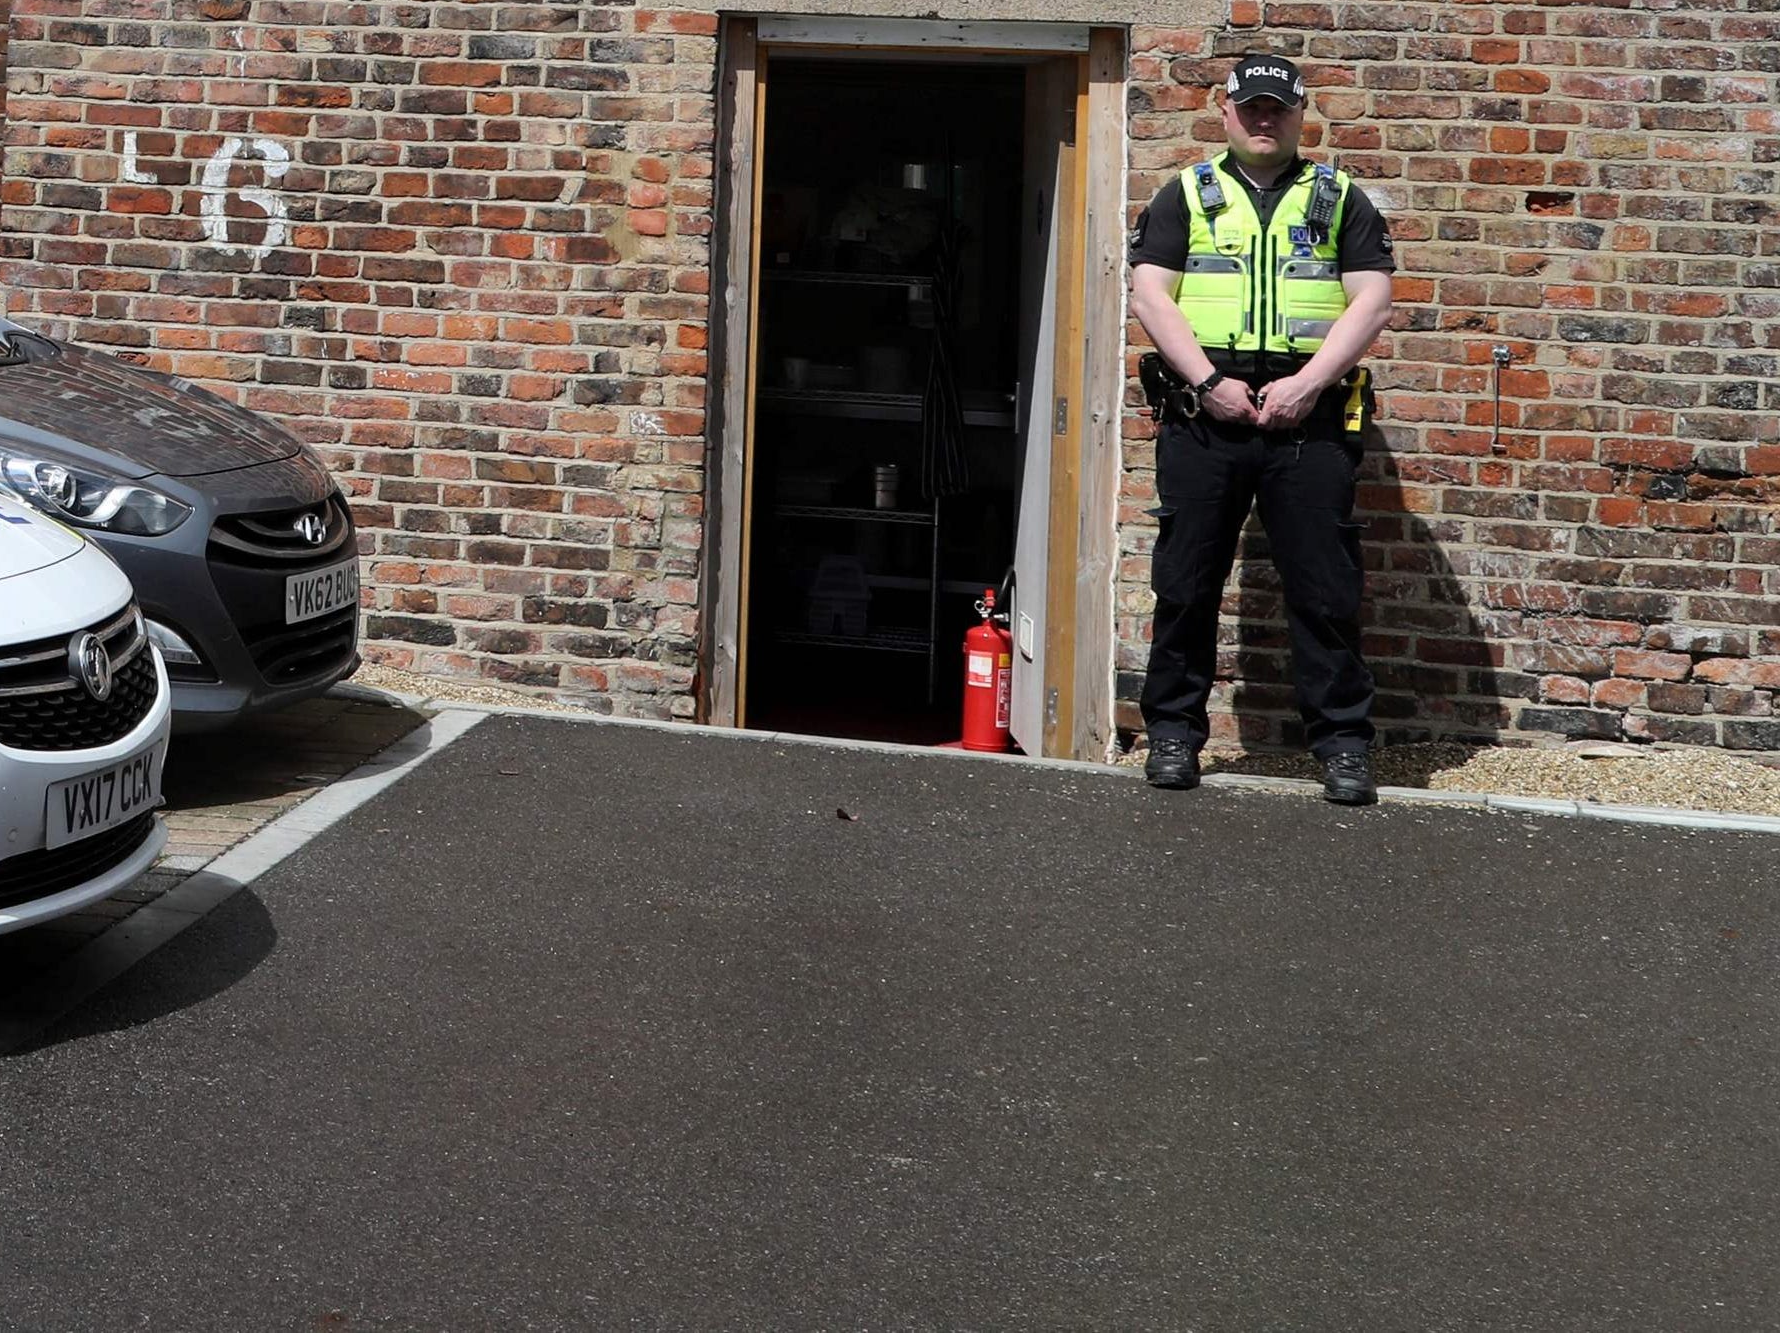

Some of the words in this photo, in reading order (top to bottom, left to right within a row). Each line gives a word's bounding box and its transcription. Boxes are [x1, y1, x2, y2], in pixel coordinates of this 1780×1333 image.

[1245, 66, 1289, 81] POLICE
[200, 138, 291, 259] 6
[294, 576, 333, 616] VK62
[64, 771, 116, 834] VX17
[120, 752, 154, 812] CCK
